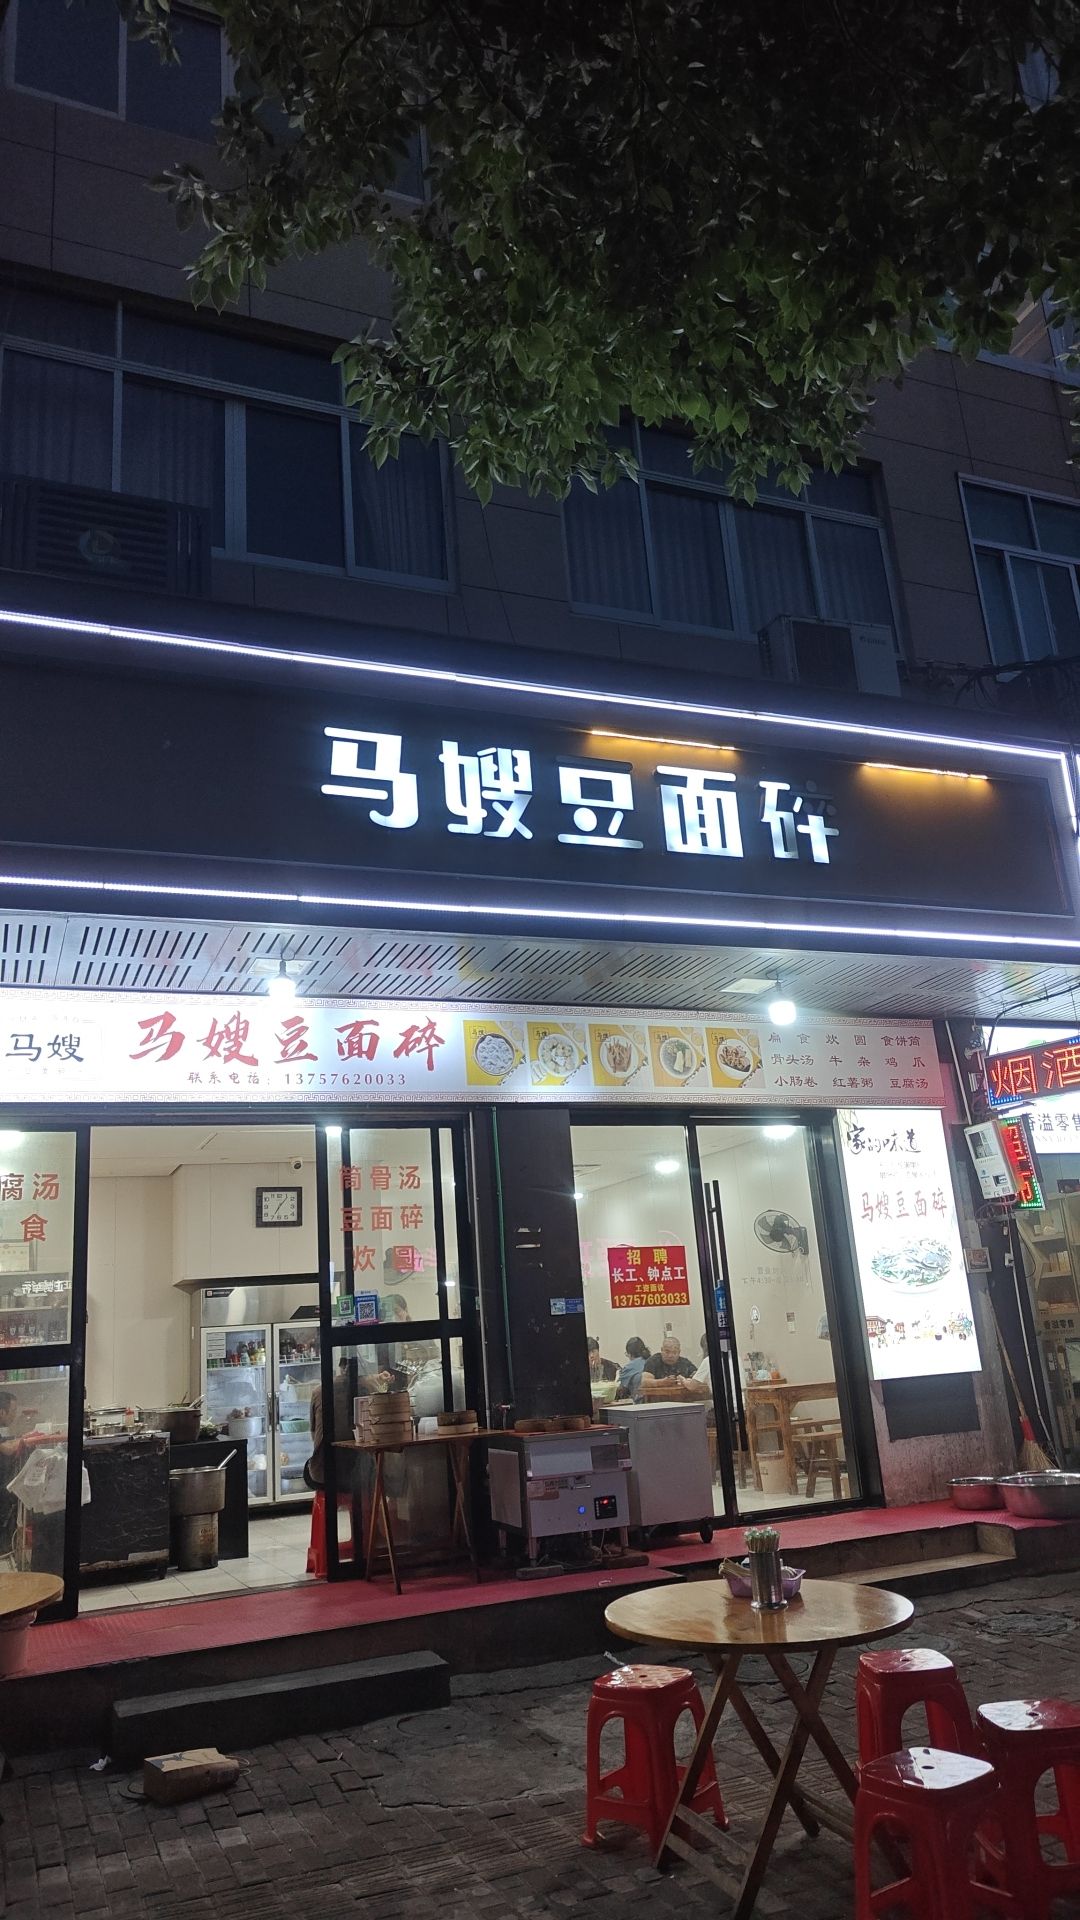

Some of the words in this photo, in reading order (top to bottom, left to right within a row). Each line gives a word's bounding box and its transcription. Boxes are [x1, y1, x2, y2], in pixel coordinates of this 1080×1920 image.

[321, 727, 840, 863] 马嫂豆面碎
[5, 1033, 84, 1062] 马嫂
[129, 1010, 445, 1071] 马嫂豆面碎
[771, 1053, 815, 1067] 骨头汤
[829, 1055, 871, 1068] 牛杂
[884, 1056, 926, 1068] 鸡爪
[991, 1046, 1080, 1098] 烟酒
[284, 1073, 407, 1086] 13757620033
[774, 1075, 818, 1089] 小肠卷
[832, 1077, 874, 1089] 红薯粥
[889, 1078, 929, 1090] 豆腐汤
[847, 1124, 921, 1154] 家的味道
[0, 1173, 60, 1201] 腐汤
[339, 1165, 421, 1191] 筒骨汤
[340, 1204, 423, 1231] 豆面碎
[861, 1187, 947, 1222] 马嫂豆面碎
[20, 1214, 48, 1242] 食
[627, 1248, 668, 1265] 招聘
[614, 1292, 688, 1307] 13757603033
